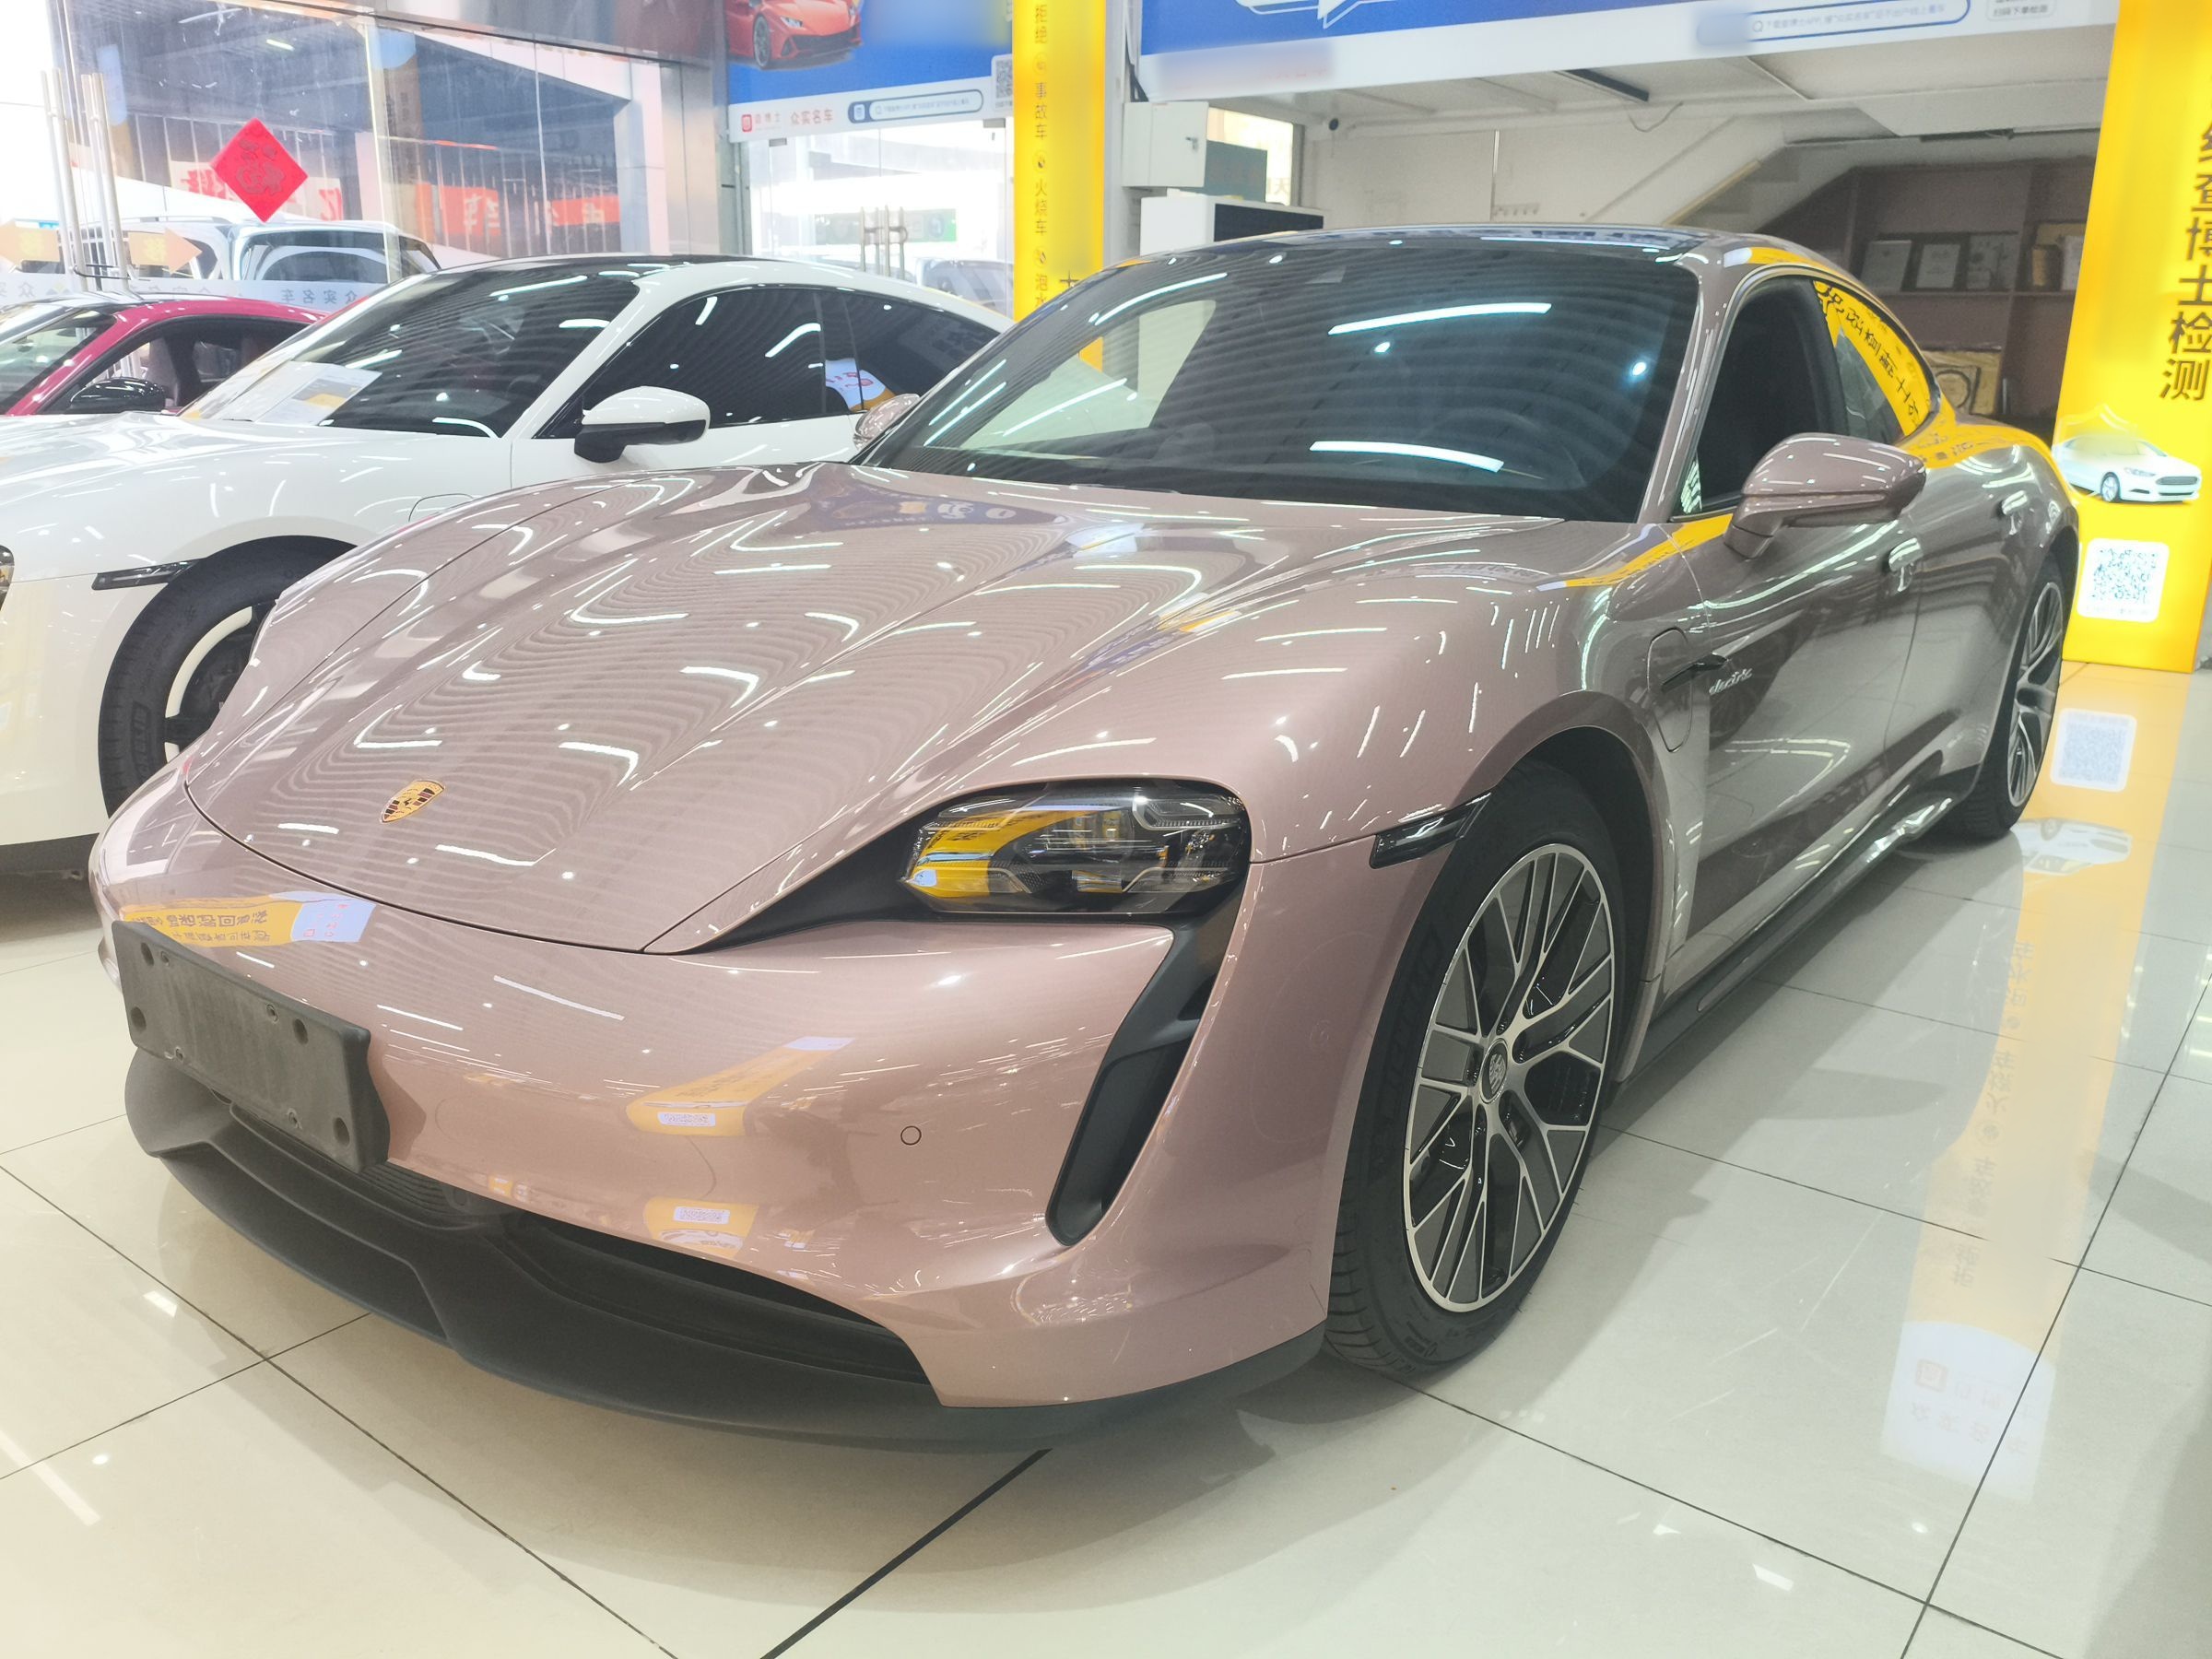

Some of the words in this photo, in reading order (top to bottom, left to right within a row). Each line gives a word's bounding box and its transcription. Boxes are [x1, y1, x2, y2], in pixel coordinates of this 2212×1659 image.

[1034, 81, 1048, 140] 事故车
[1034, 179, 1048, 236] 火烧车
[1708, 667, 1753, 696] electric
